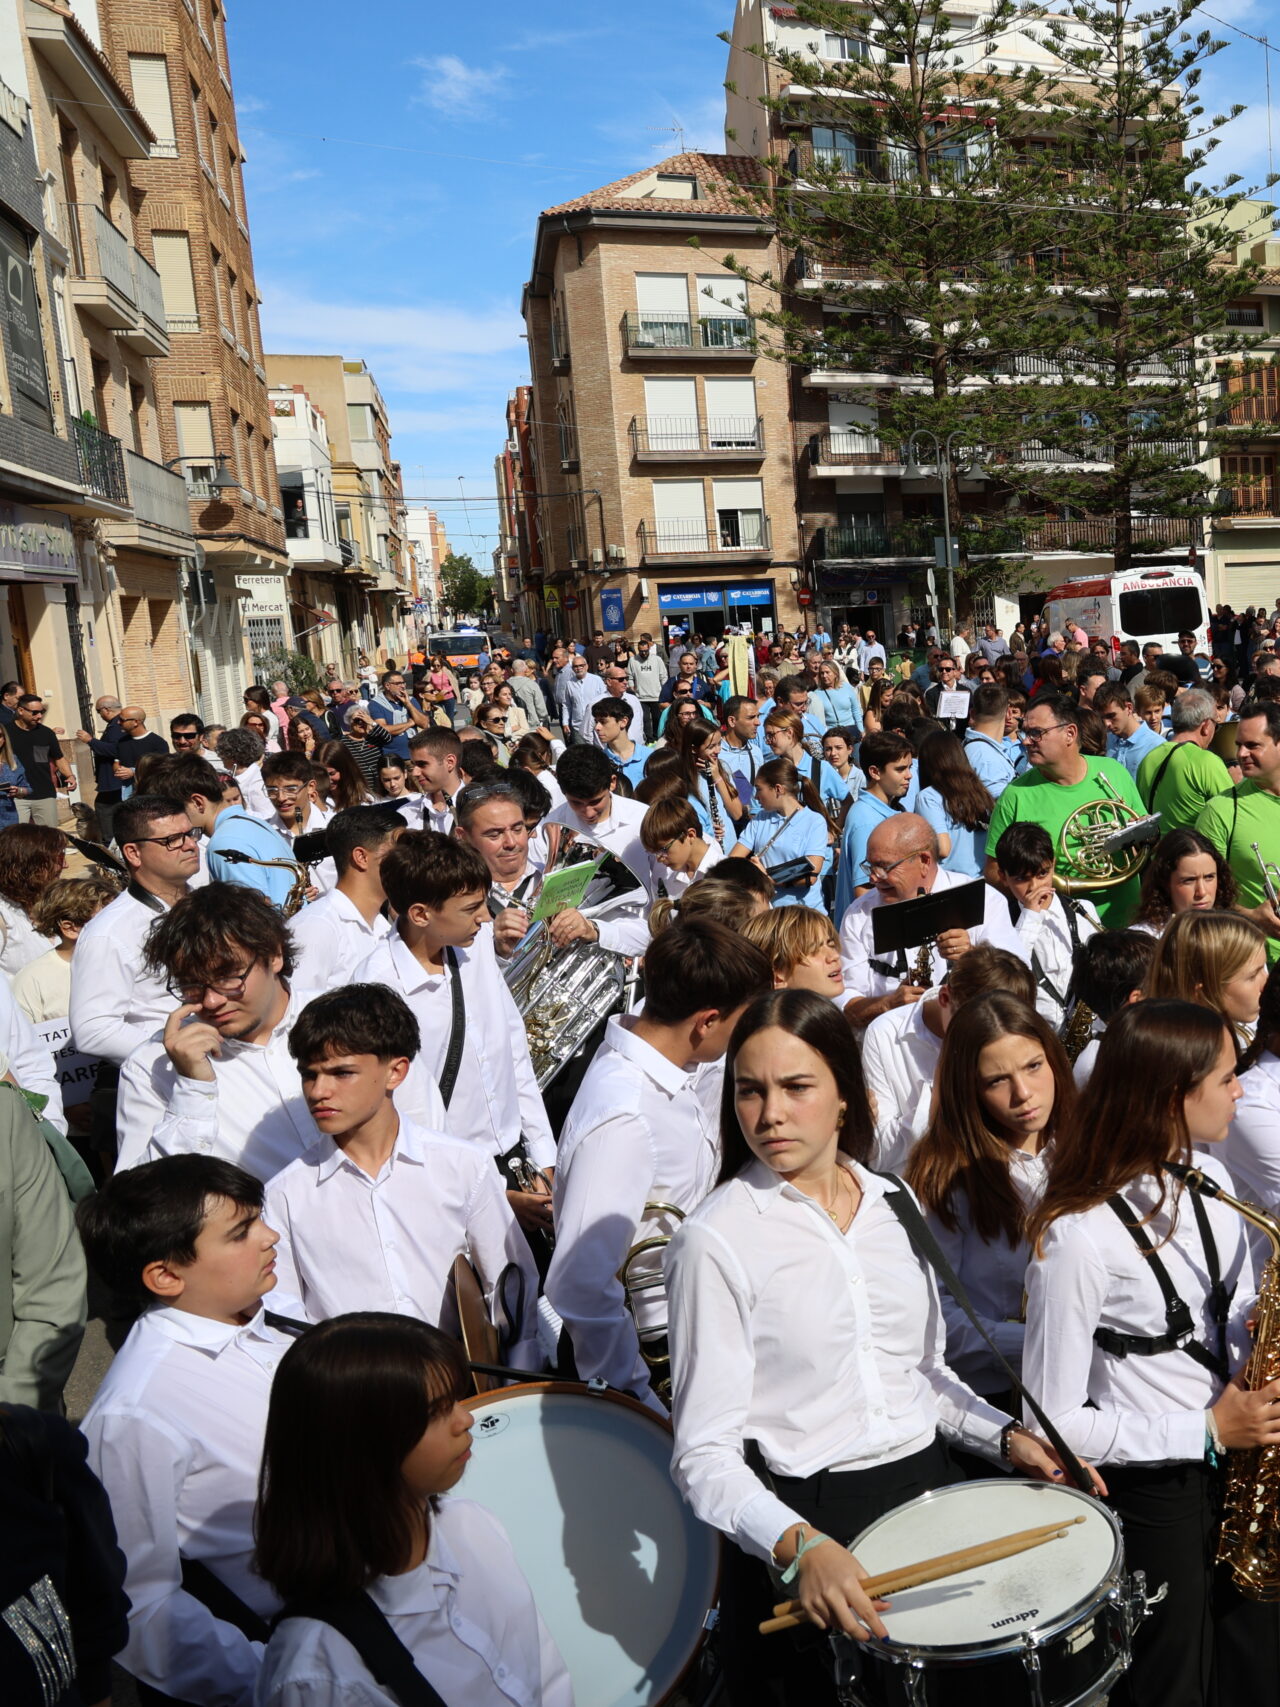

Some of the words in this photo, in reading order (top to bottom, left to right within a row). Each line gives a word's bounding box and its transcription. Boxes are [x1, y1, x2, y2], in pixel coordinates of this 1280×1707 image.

[241, 603, 250, 612] El
[252, 603, 284, 612] Mercat
[39, 1028, 69, 1043] TAT
[51, 1046, 79, 1061] TES
[990, 1608, 1040, 1629] ddrum
